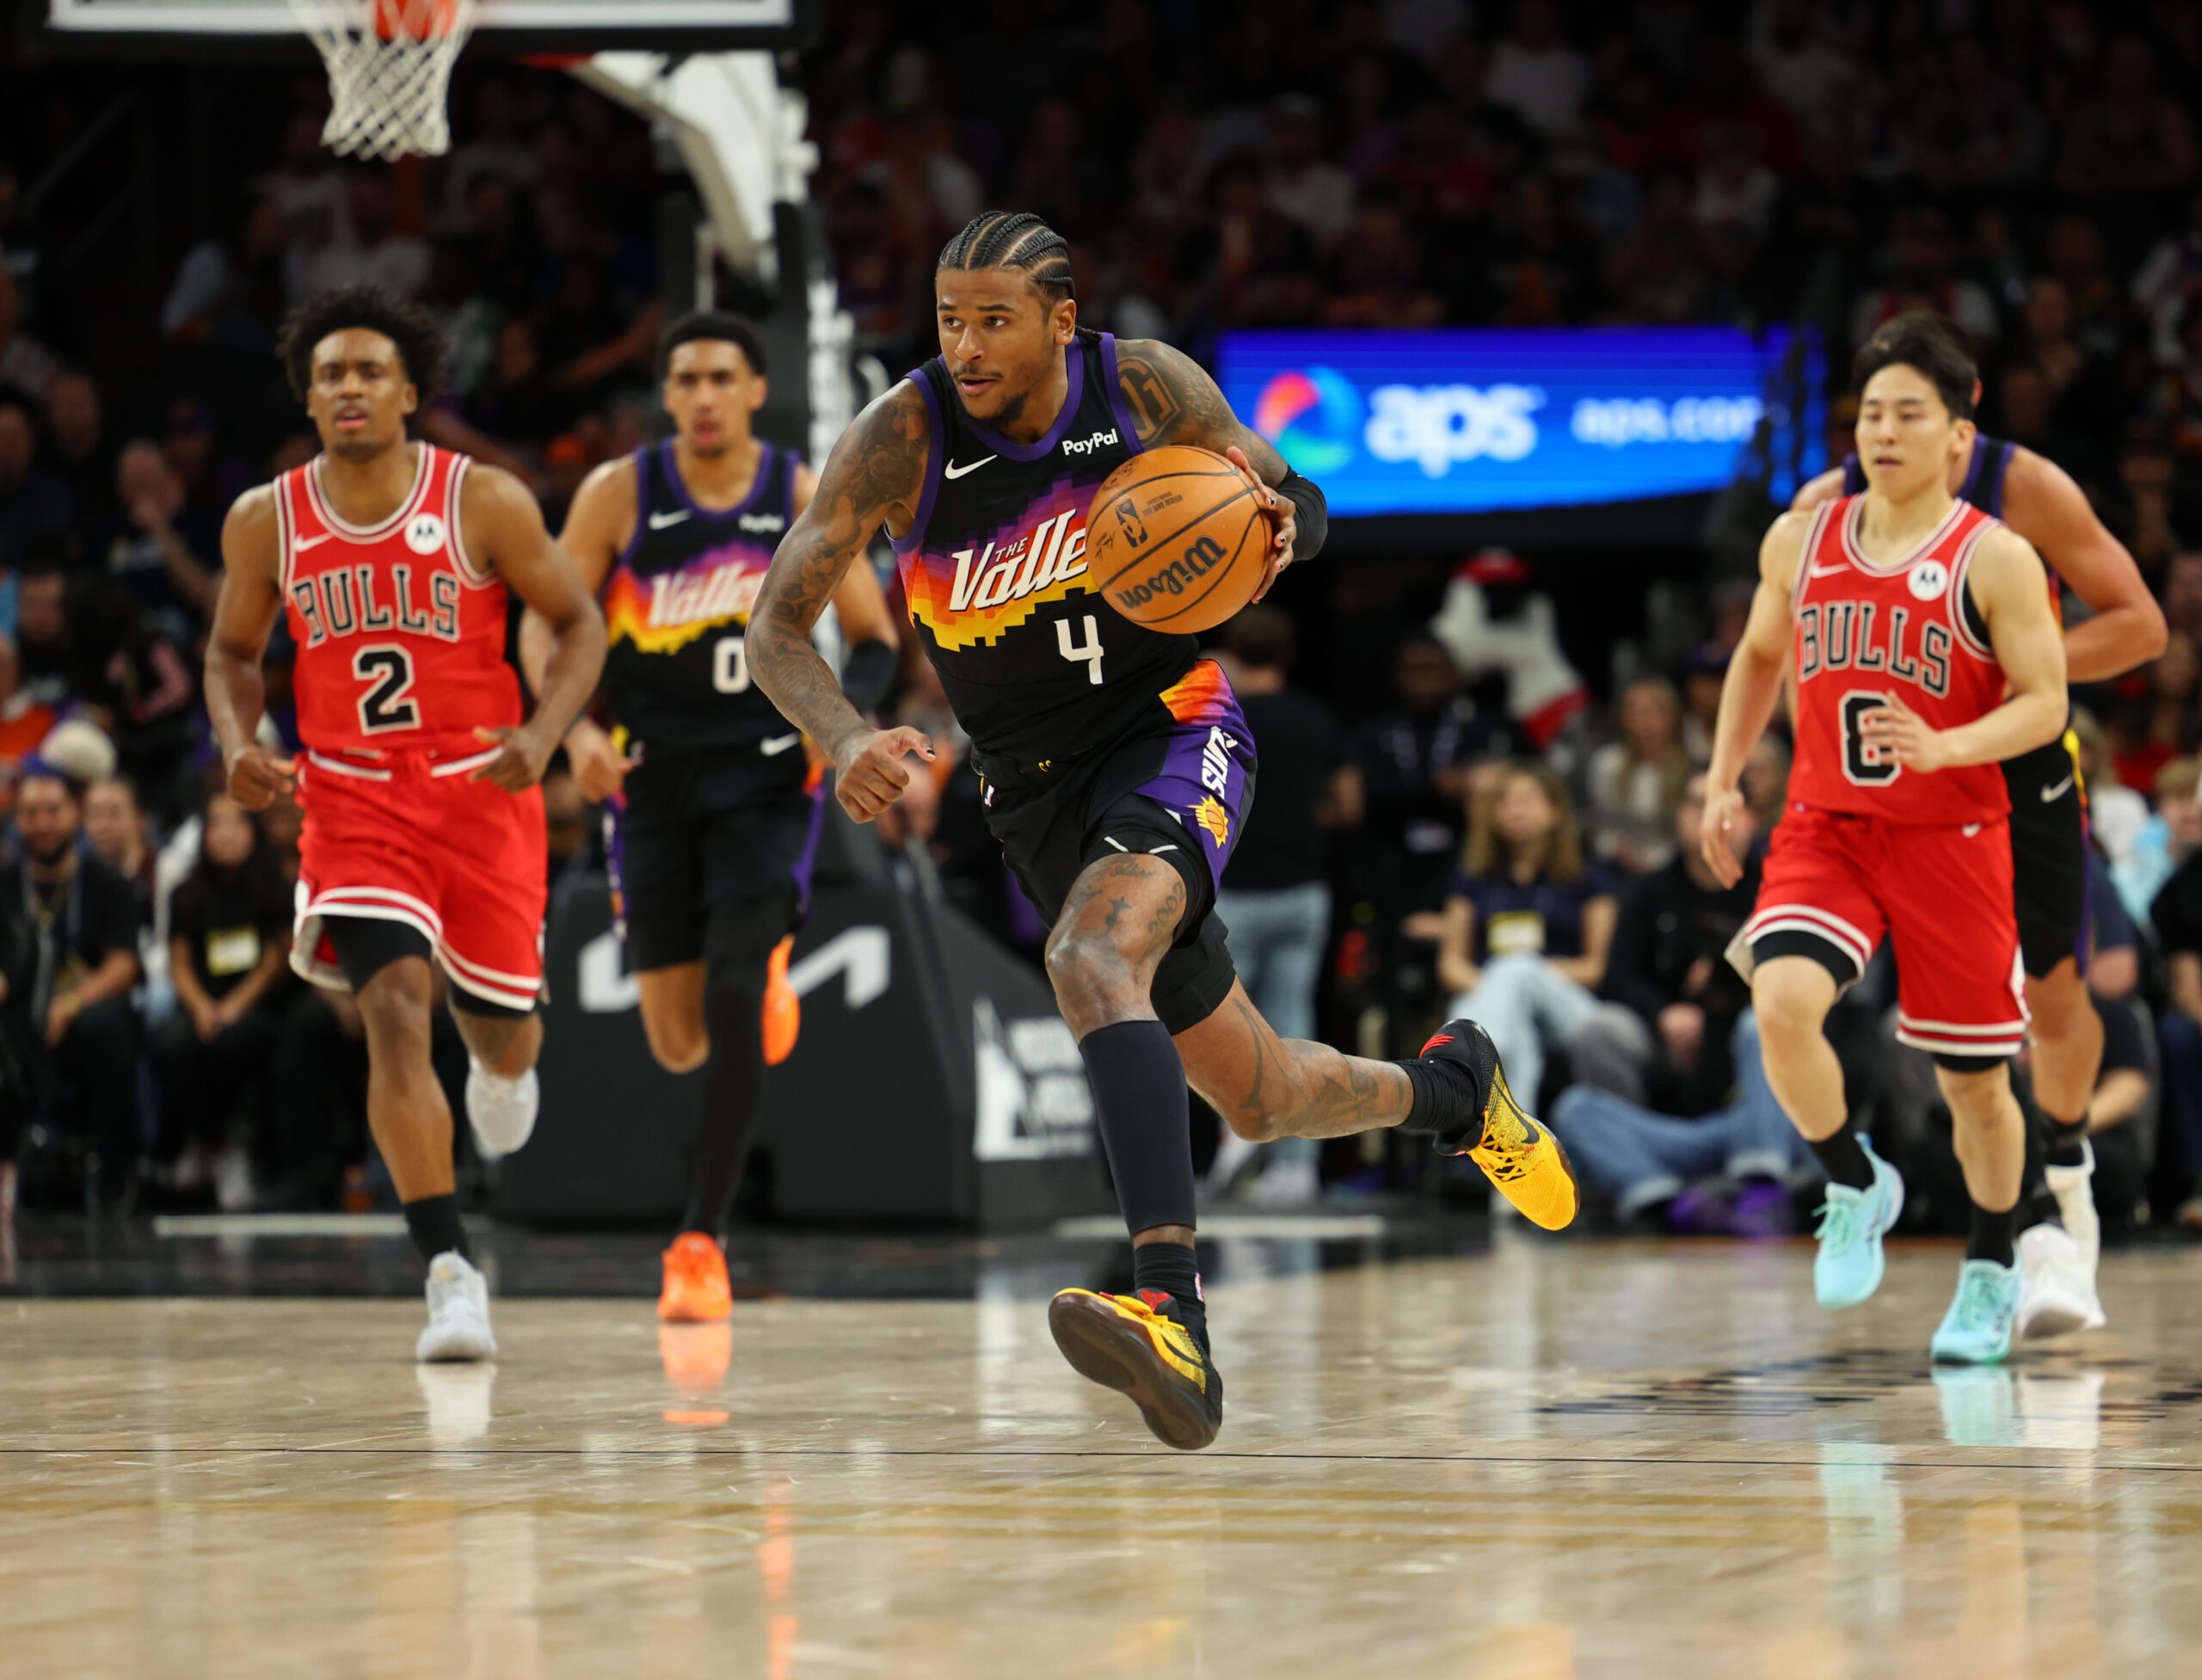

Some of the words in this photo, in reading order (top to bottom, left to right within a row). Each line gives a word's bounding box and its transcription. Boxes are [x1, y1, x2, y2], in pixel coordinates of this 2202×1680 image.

[1061, 428, 1119, 456] PayPal
[1364, 385, 1537, 479] aps
[949, 508, 1090, 611] Valle
[995, 536, 1029, 563] THE
[1115, 534, 1228, 610] Wilson
[713, 637, 750, 694] 0
[1054, 615, 1104, 685] 4
[1799, 601, 1952, 699] BULLS
[352, 643, 421, 735] 2
